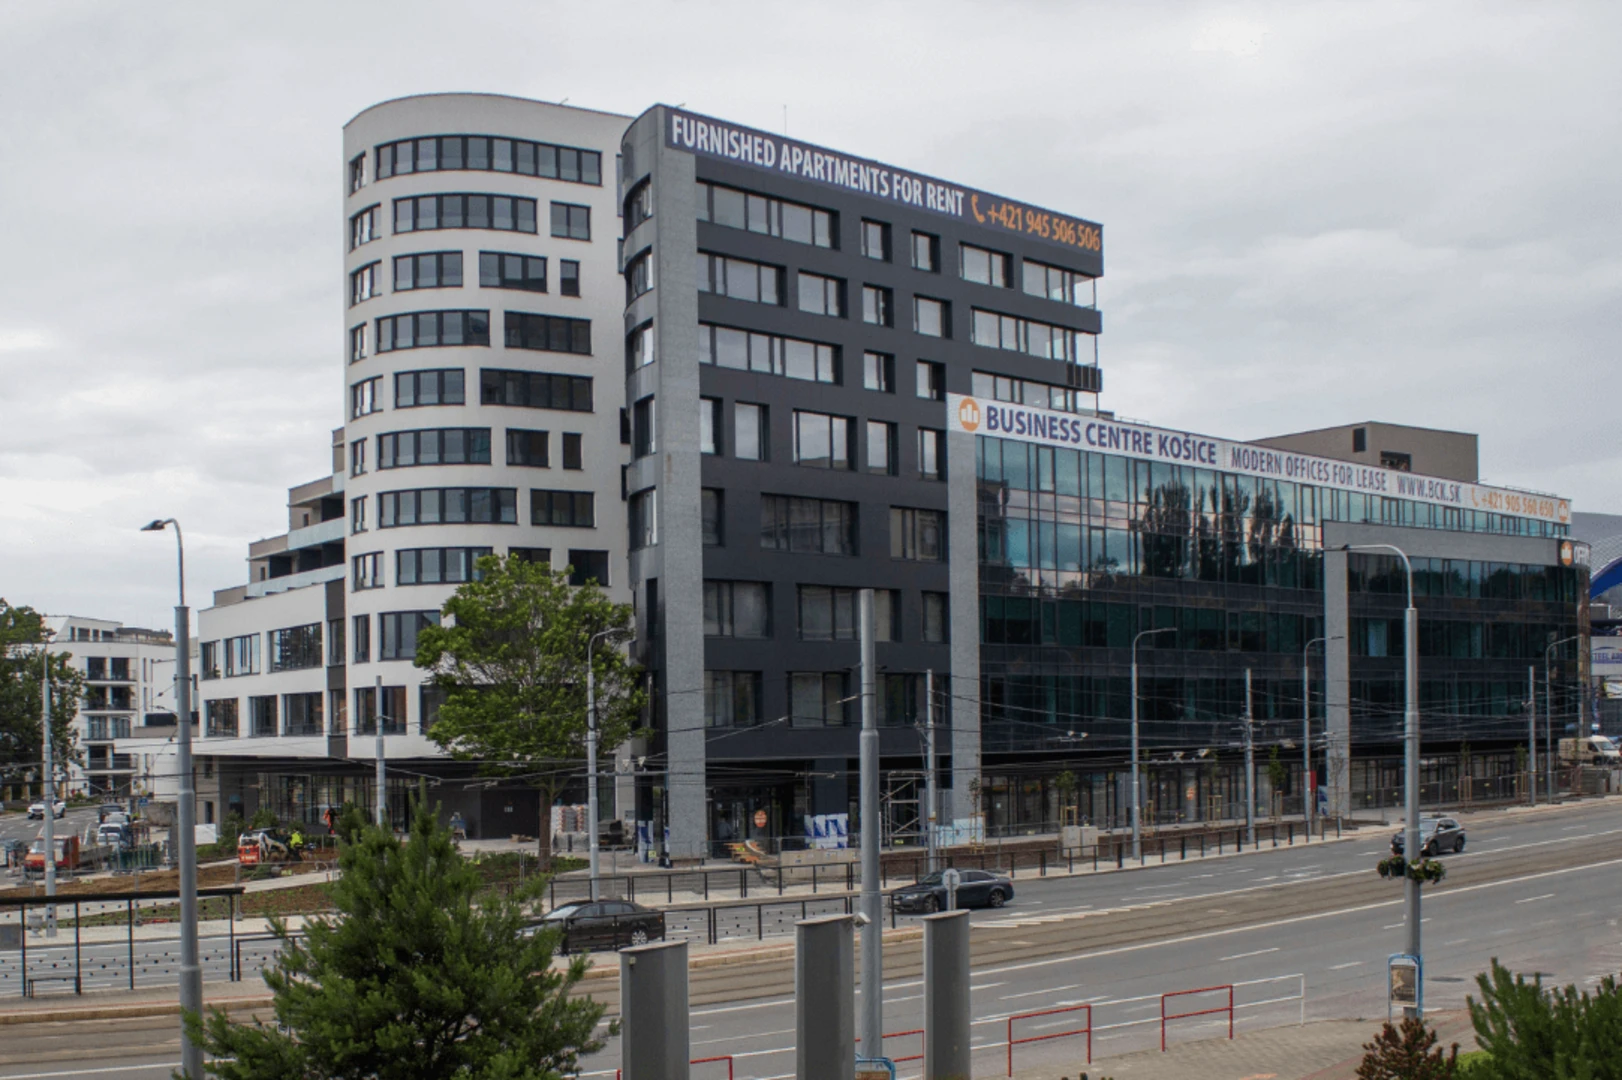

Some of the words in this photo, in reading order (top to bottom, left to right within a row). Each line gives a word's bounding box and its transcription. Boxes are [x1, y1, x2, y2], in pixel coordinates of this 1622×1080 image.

[672, 114, 776, 168] FURNISHED
[780, 143, 890, 197] APARTMENTS
[893, 173, 923, 206] FOR
[926, 182, 965, 217] RENT
[987, 203, 1022, 231] +421
[1026, 210, 1050, 238] 945
[1052, 218, 1076, 245] 506
[1078, 223, 1100, 251] 506
[987, 405, 1081, 443] BUSINESS
[1085, 422, 1153, 455] CENTRE
[1158, 432, 1216, 464] KOŠICE
[1231, 446, 1282, 475] MODERN
[1285, 456, 1330, 482] OFFICES
[1332, 464, 1353, 487] FOR
[1356, 468, 1387, 492] LEASE
[1397, 474, 1462, 502] WWW.BCK.SK
